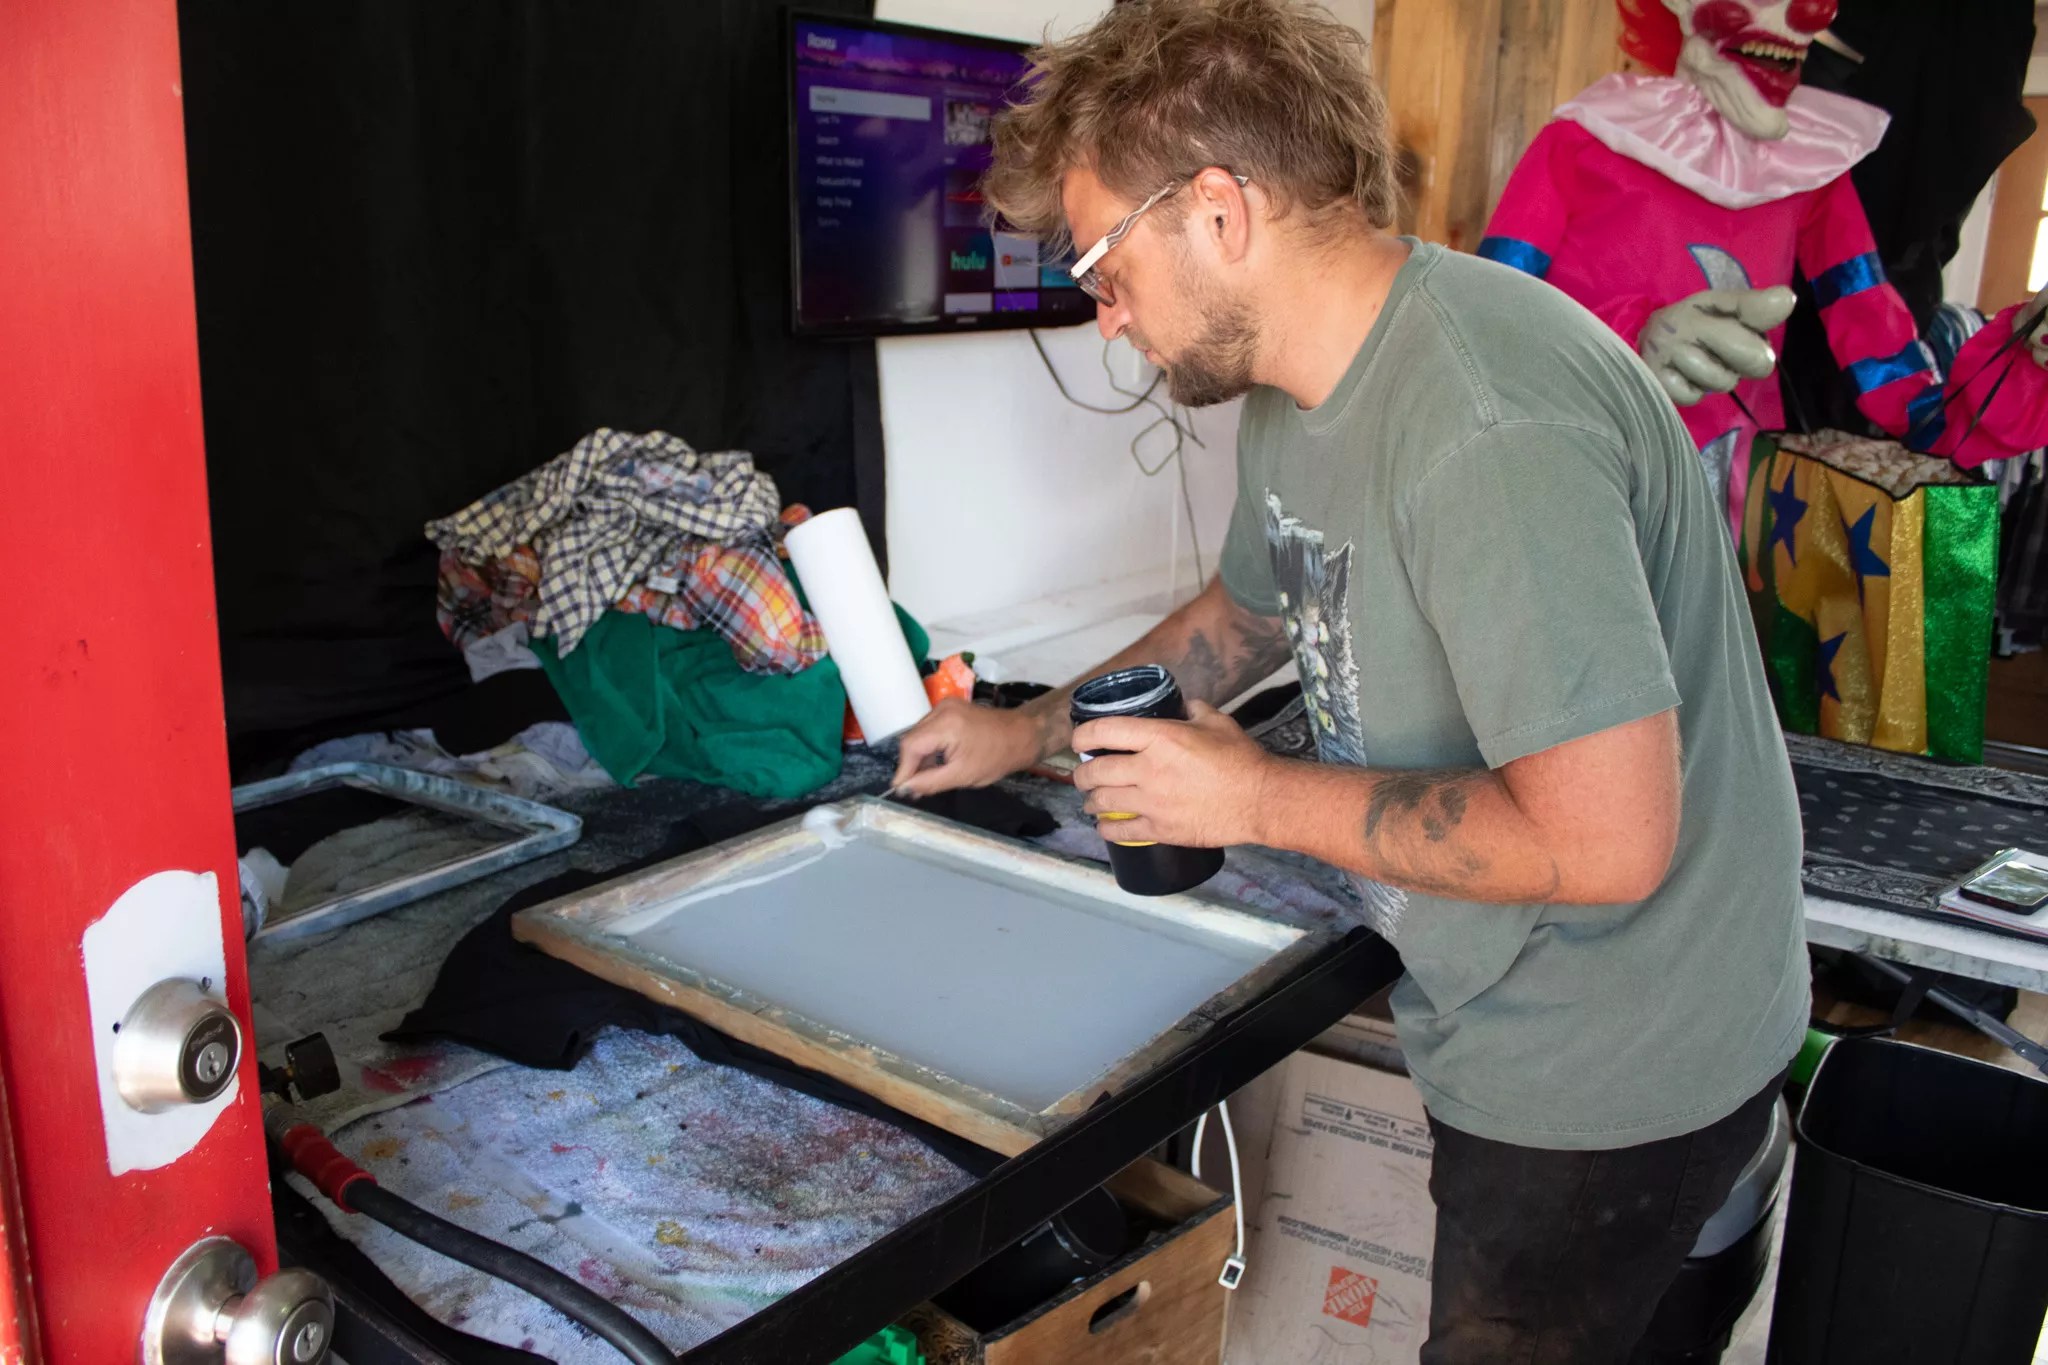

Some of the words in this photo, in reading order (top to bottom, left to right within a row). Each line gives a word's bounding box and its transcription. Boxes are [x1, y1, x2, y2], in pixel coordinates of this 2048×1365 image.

[951, 252, 986, 270] hulu
[1316, 1239, 1342, 1254] YOUR
[1363, 1241, 1391, 1258] NEEDS
[1345, 1246, 1385, 1266] ESTIMATE
[1324, 1278, 1376, 1315] HOME
